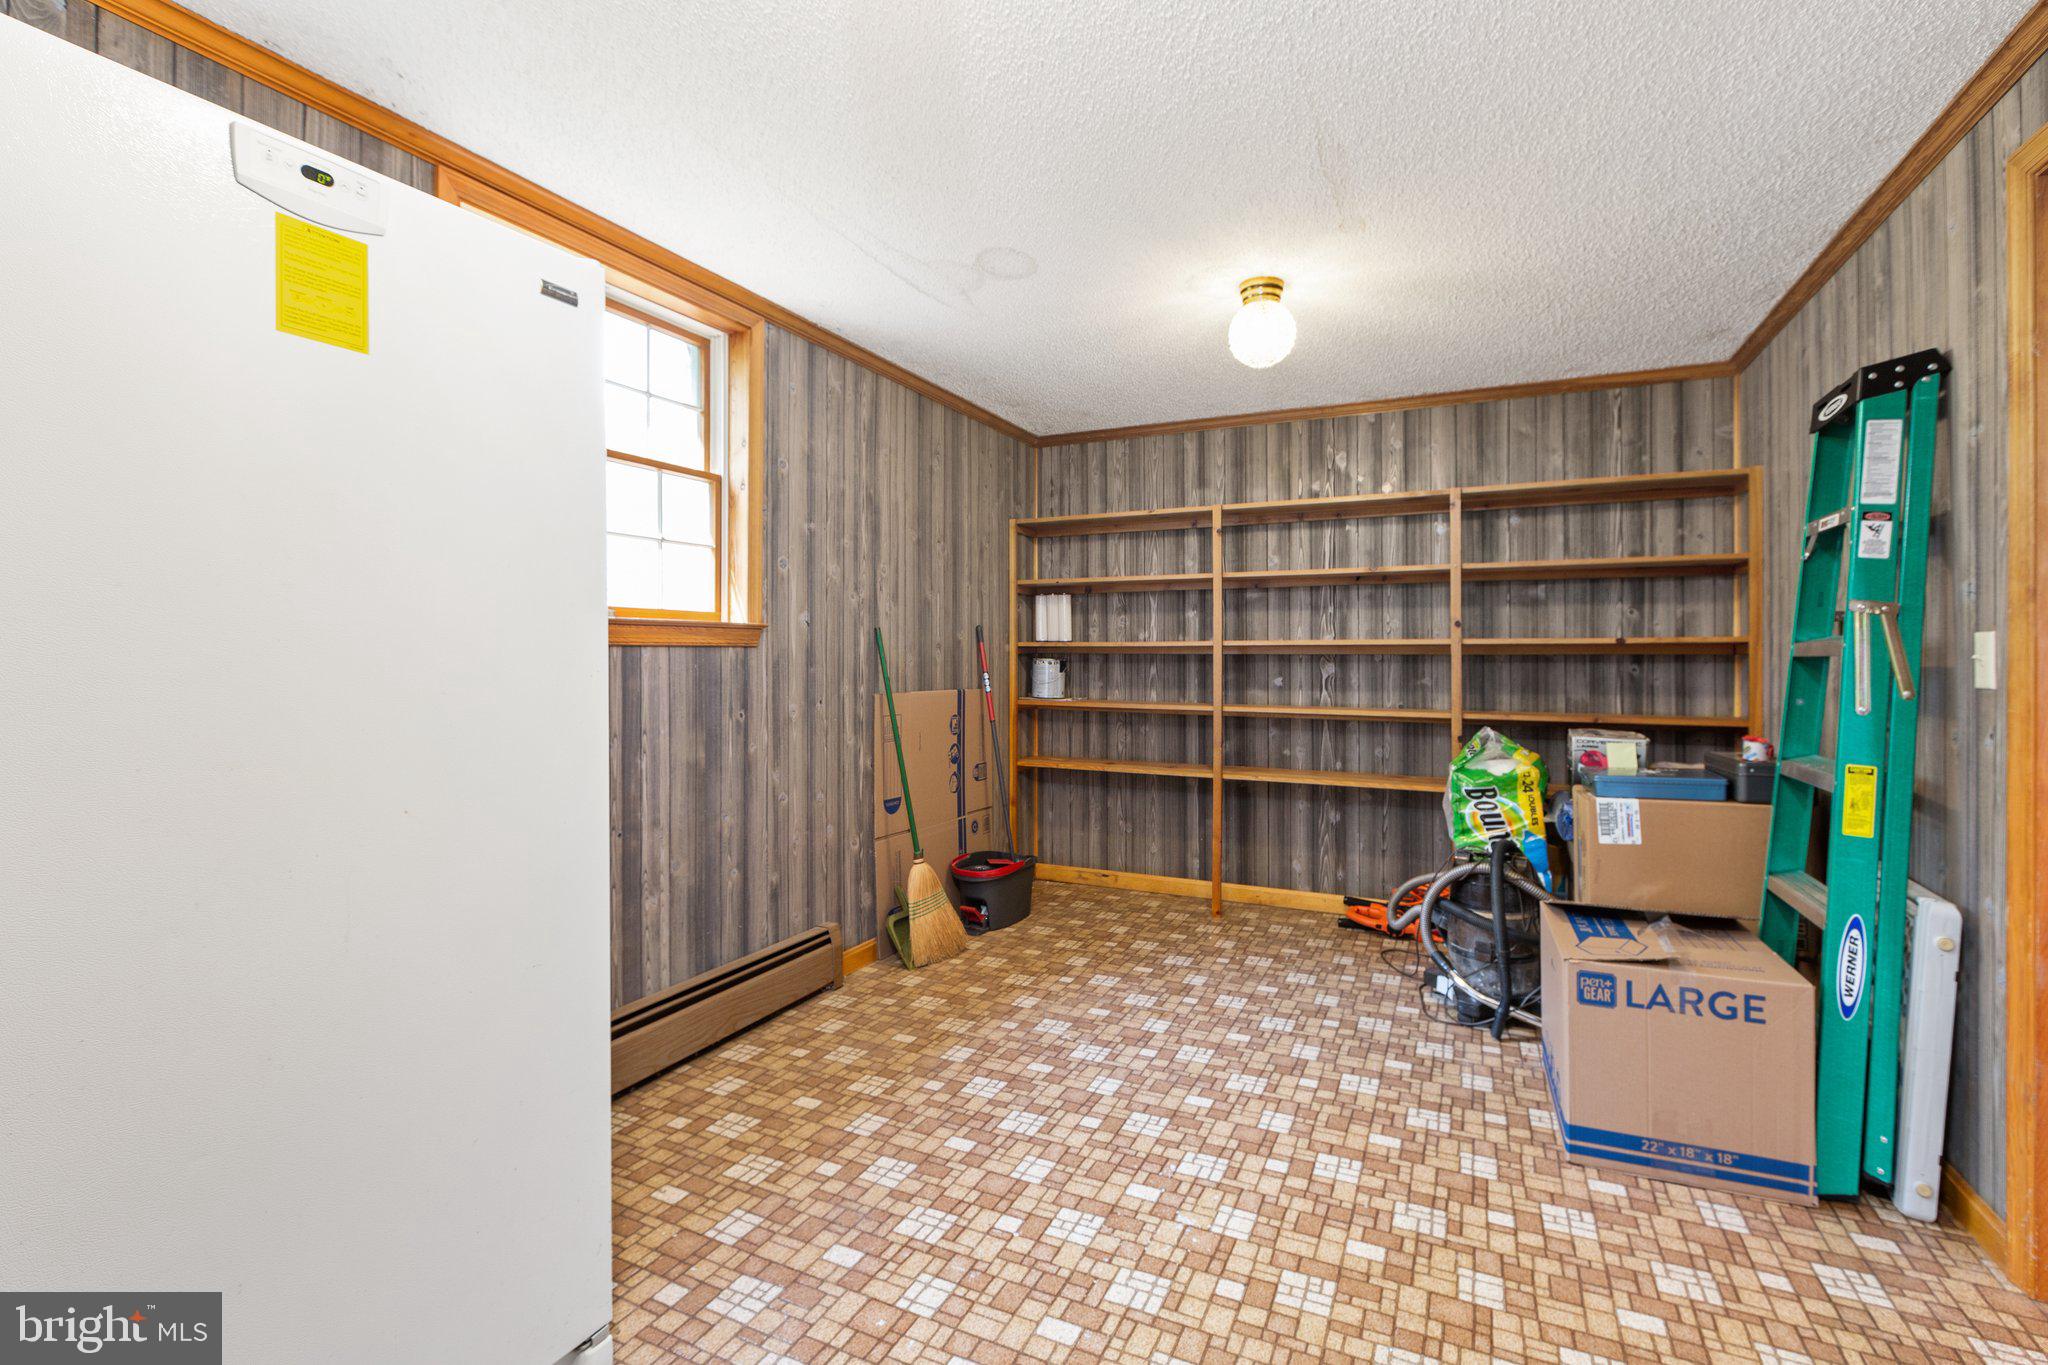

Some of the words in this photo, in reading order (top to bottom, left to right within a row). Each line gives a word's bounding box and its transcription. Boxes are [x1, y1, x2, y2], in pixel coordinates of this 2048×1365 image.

[1464, 786, 1511, 840] Boun
[1580, 976, 1612, 989] pen+
[1844, 935, 1859, 998] WERNER
[1584, 986, 1611, 1002] GEAR
[1626, 979, 1766, 1025] LARGE
